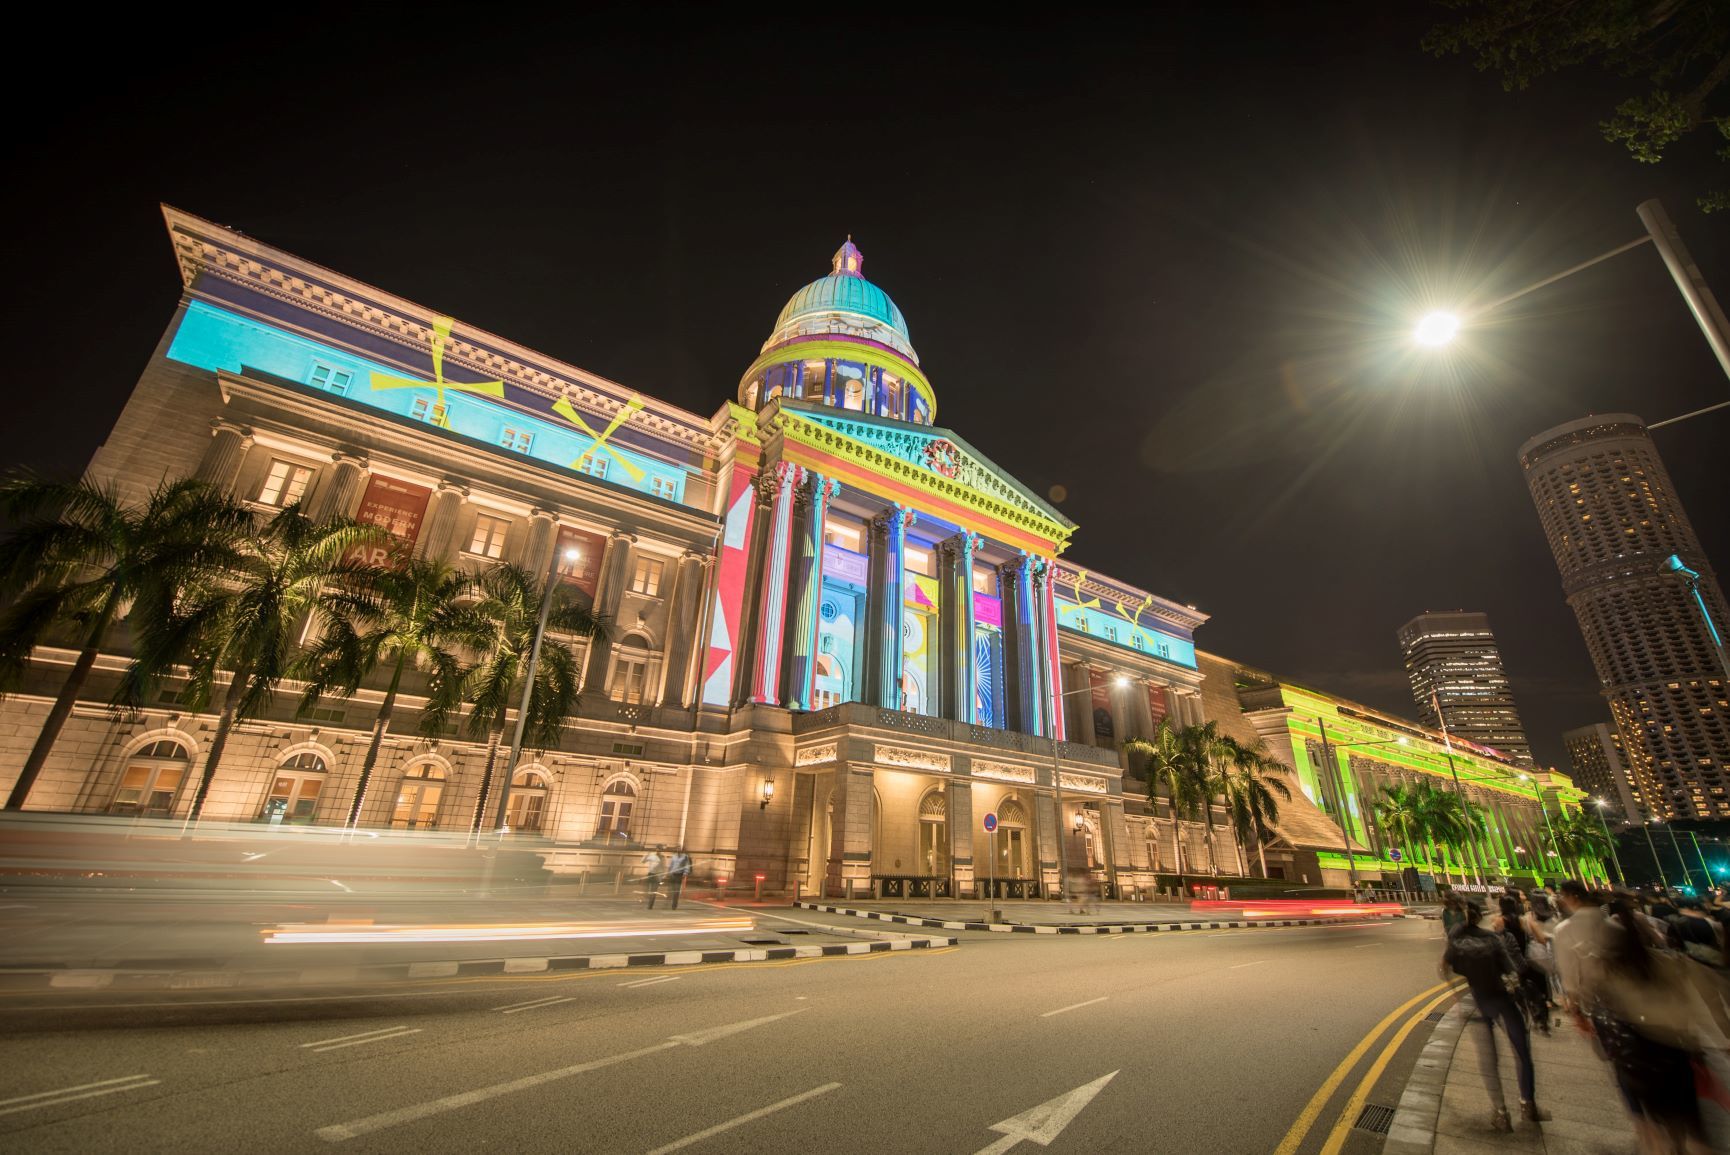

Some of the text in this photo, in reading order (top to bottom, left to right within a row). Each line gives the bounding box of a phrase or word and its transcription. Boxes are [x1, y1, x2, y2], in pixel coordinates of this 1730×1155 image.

[367, 502, 419, 519] EXPERIENCE
[363, 511, 416, 530] MODERN
[350, 544, 403, 567] AR
